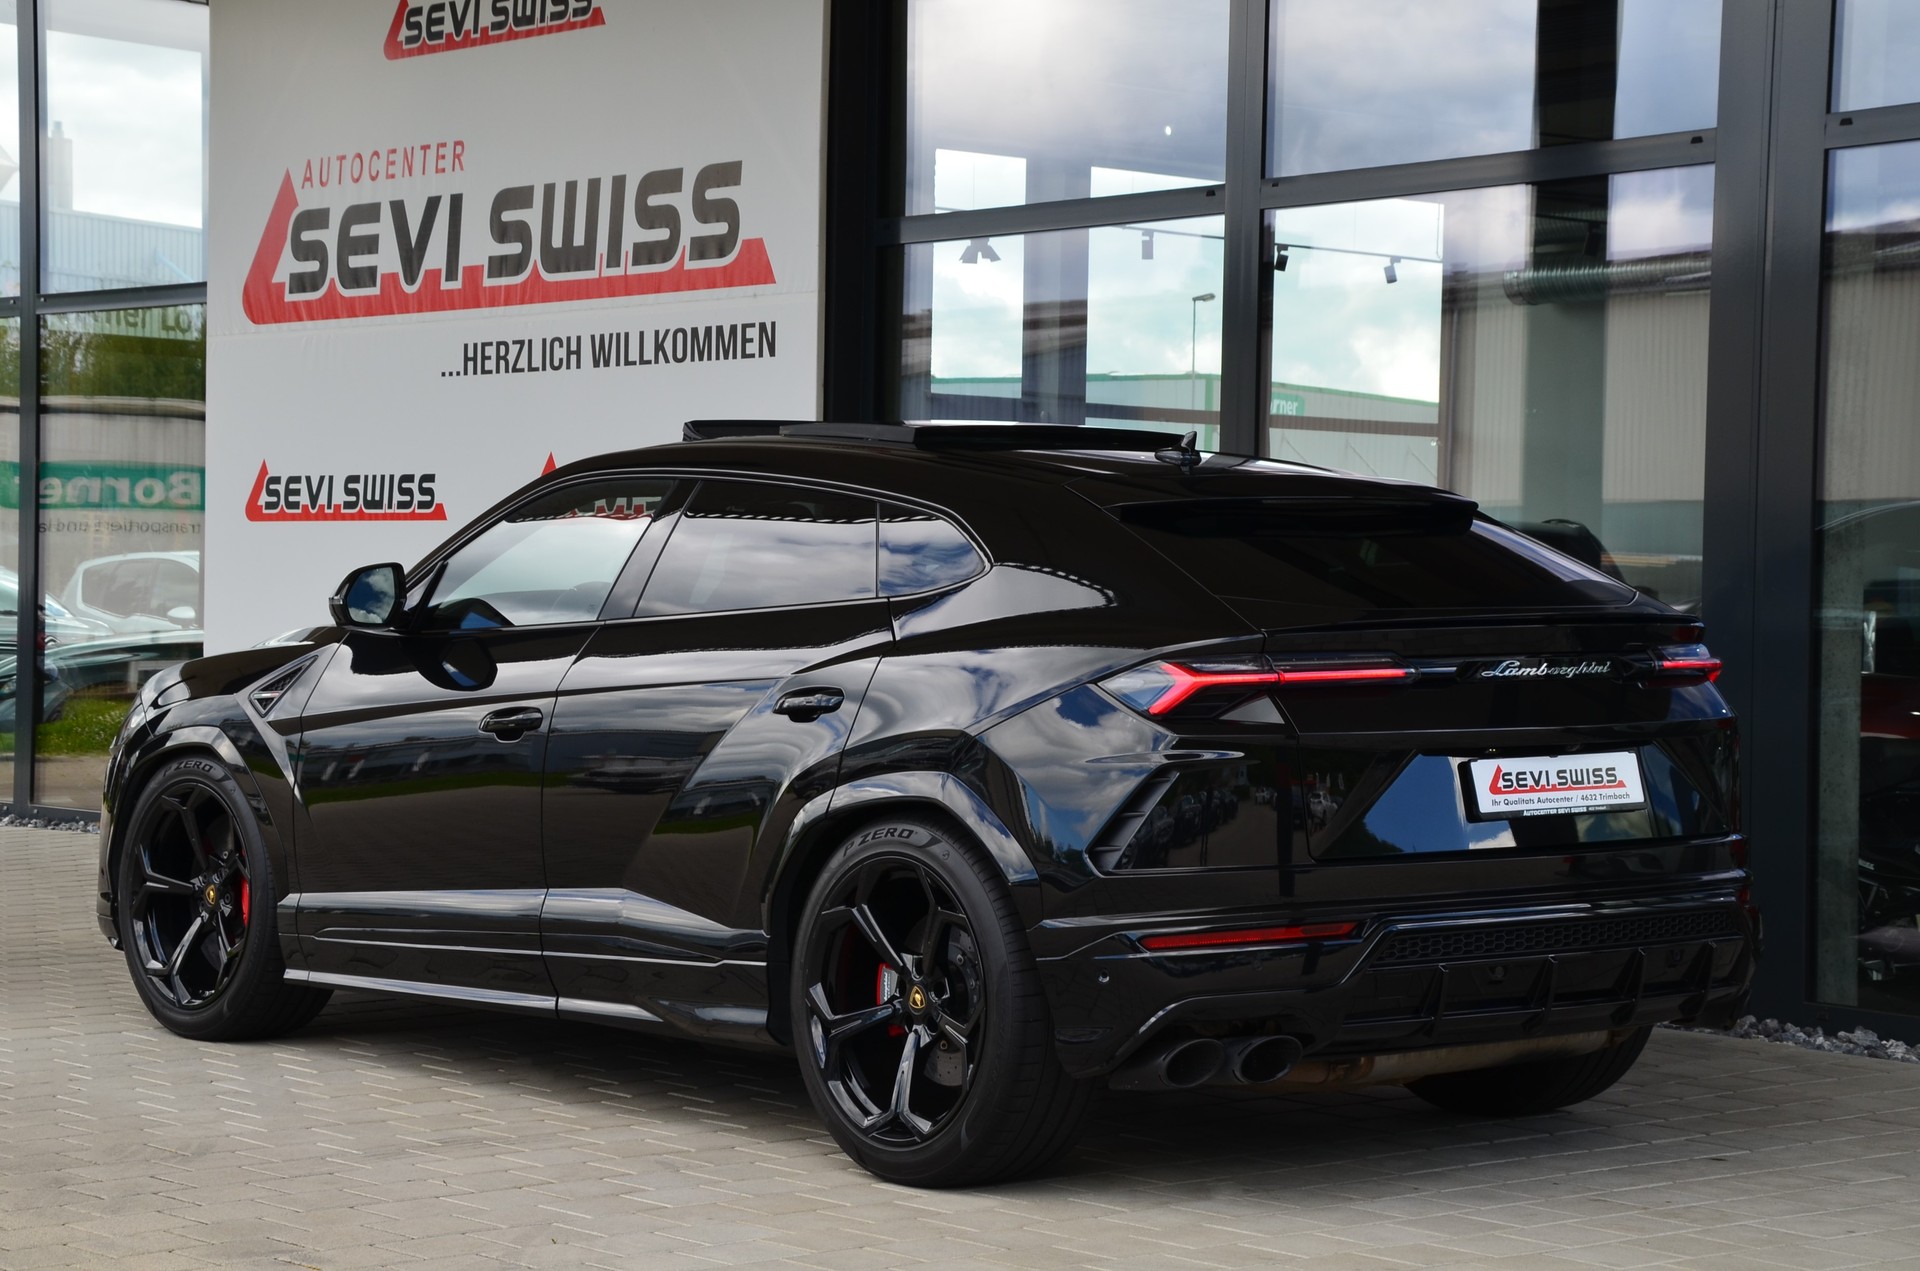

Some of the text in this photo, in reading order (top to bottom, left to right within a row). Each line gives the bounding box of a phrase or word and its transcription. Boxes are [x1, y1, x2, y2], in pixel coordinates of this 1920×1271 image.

[403, 0, 481, 46] SEVI
[301, 140, 466, 190] AUTOCENTER
[288, 160, 743, 295] SEVI SWISS
[440, 320, 777, 377] ...HERZLICH WILLKOMMEN
[264, 473, 437, 511] SEVI SWISS
[1481, 660, 1611, 678] Lamborghini
[174, 760, 213, 772] ZERO
[1501, 767, 1617, 789] SEVI SWISS
[1537, 795, 1573, 804] Autocenter
[1580, 793, 1598, 801] 4632
[1599, 792, 1631, 800] Trimbach
[859, 827, 914, 847] ZERO
